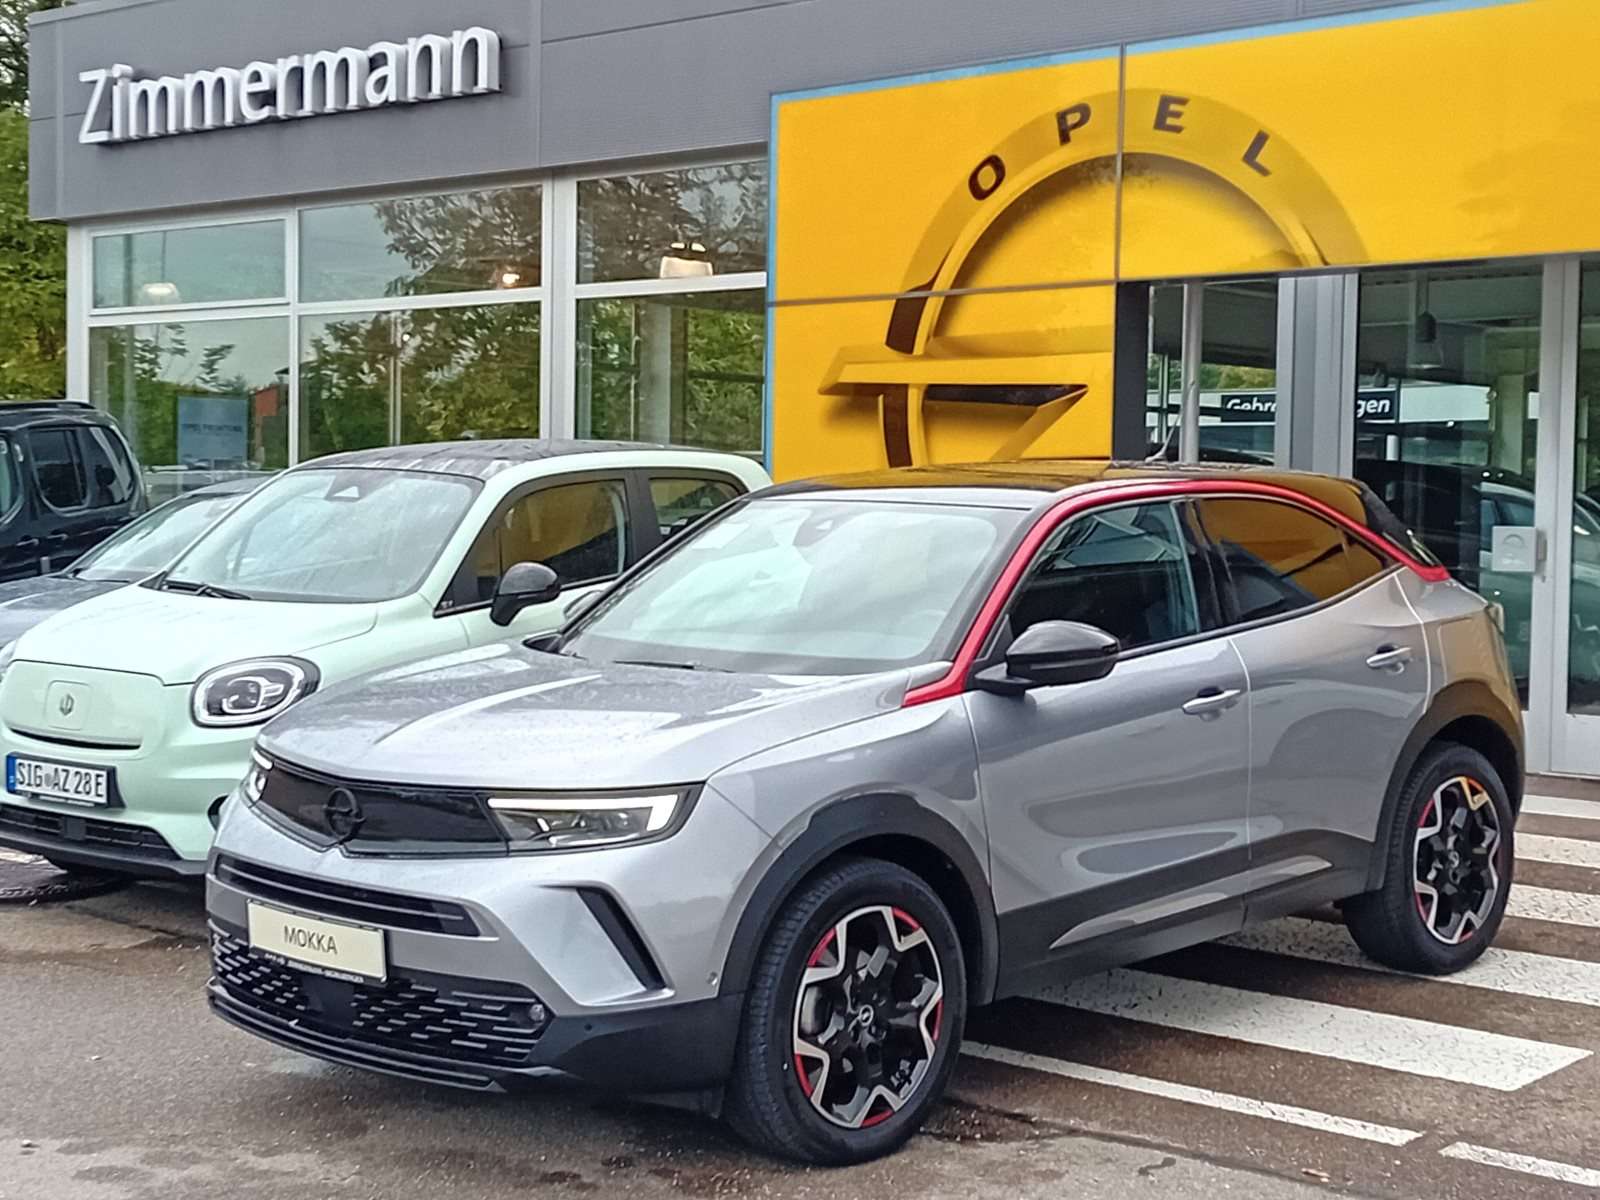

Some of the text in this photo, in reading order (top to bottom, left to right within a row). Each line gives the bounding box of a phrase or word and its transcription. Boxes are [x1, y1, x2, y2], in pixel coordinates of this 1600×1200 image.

[79, 26, 501, 144] Zimmermann
[968, 94, 1274, 200] OPEL
[17, 762, 43, 788] SIG
[52, 767, 70, 792] AZ
[283, 925, 338, 955] MOKKA
